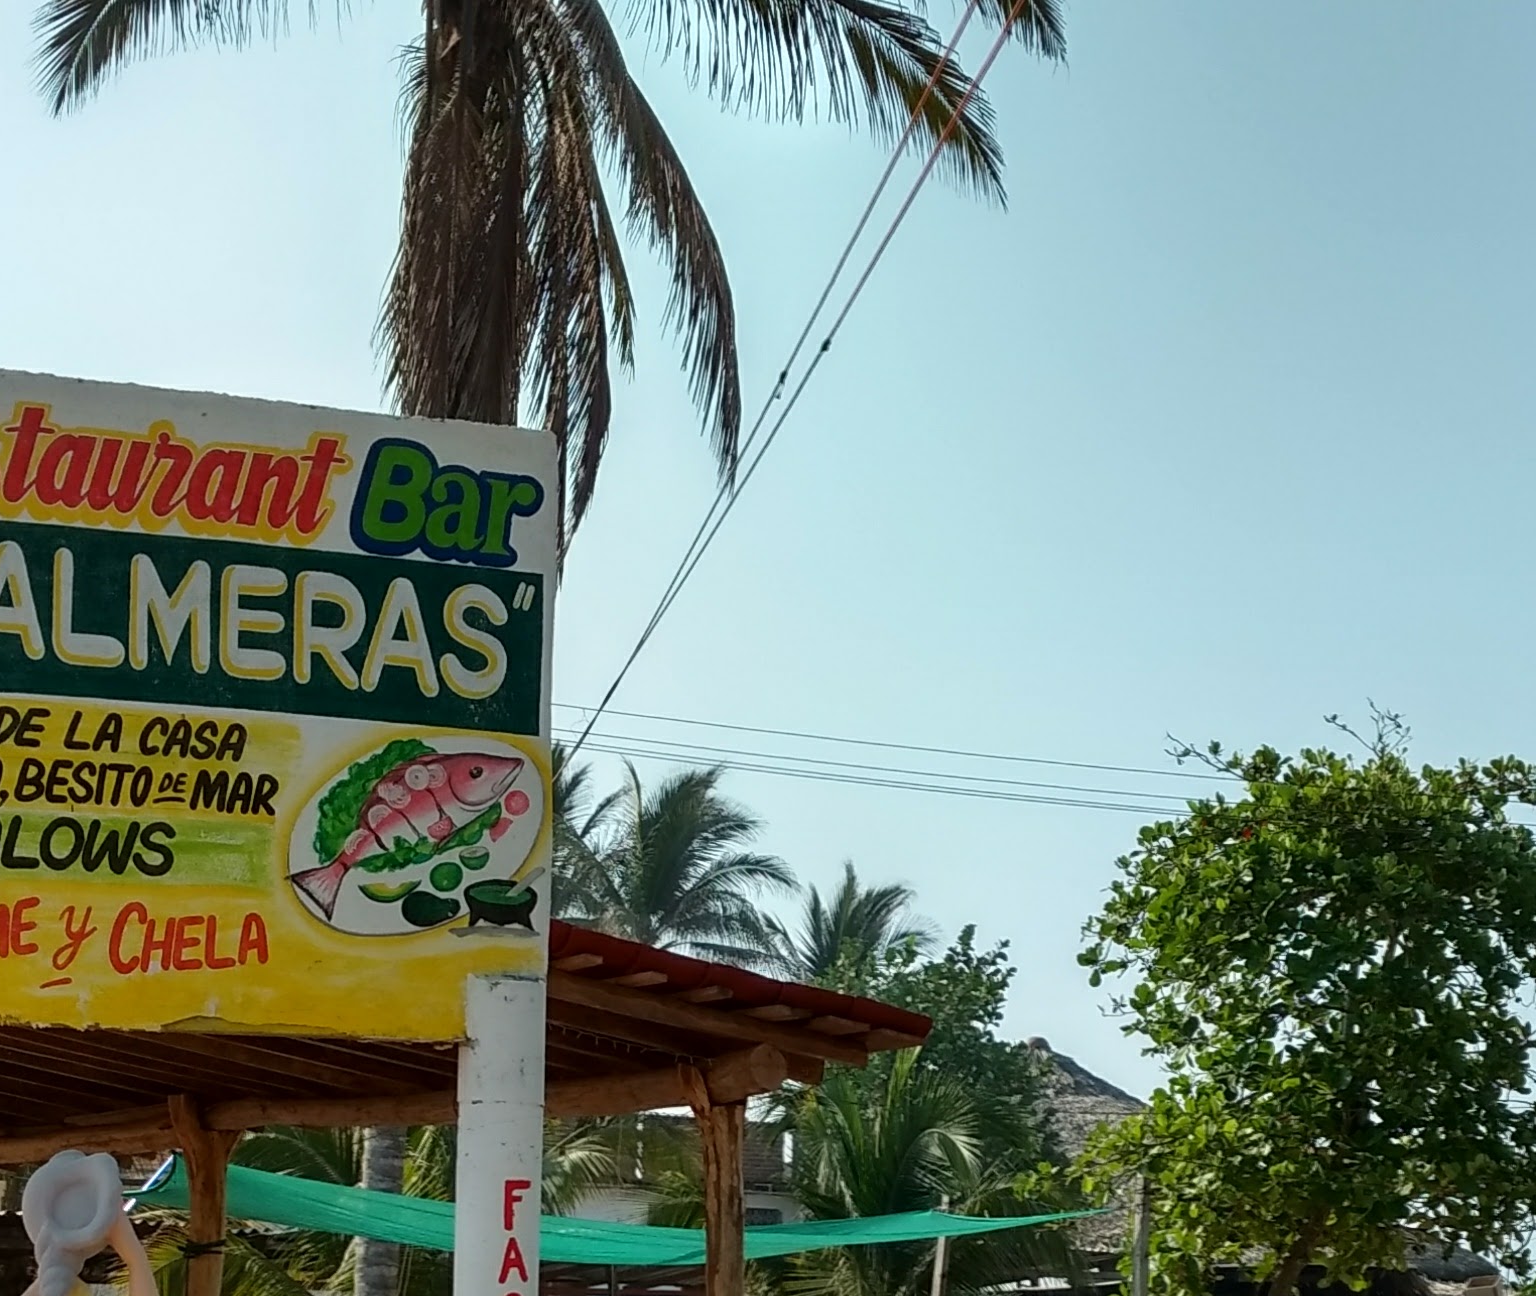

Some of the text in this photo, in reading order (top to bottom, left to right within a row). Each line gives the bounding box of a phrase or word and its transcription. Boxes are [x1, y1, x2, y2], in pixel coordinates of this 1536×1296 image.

[357, 442, 540, 560] Bar
[63, 709, 124, 753] LA
[138, 715, 249, 763] CASA
[13, 757, 154, 808] BESITO
[157, 771, 188, 796] DE
[189, 768, 280, 817] MAR
[108, 901, 270, 976] CHELA
